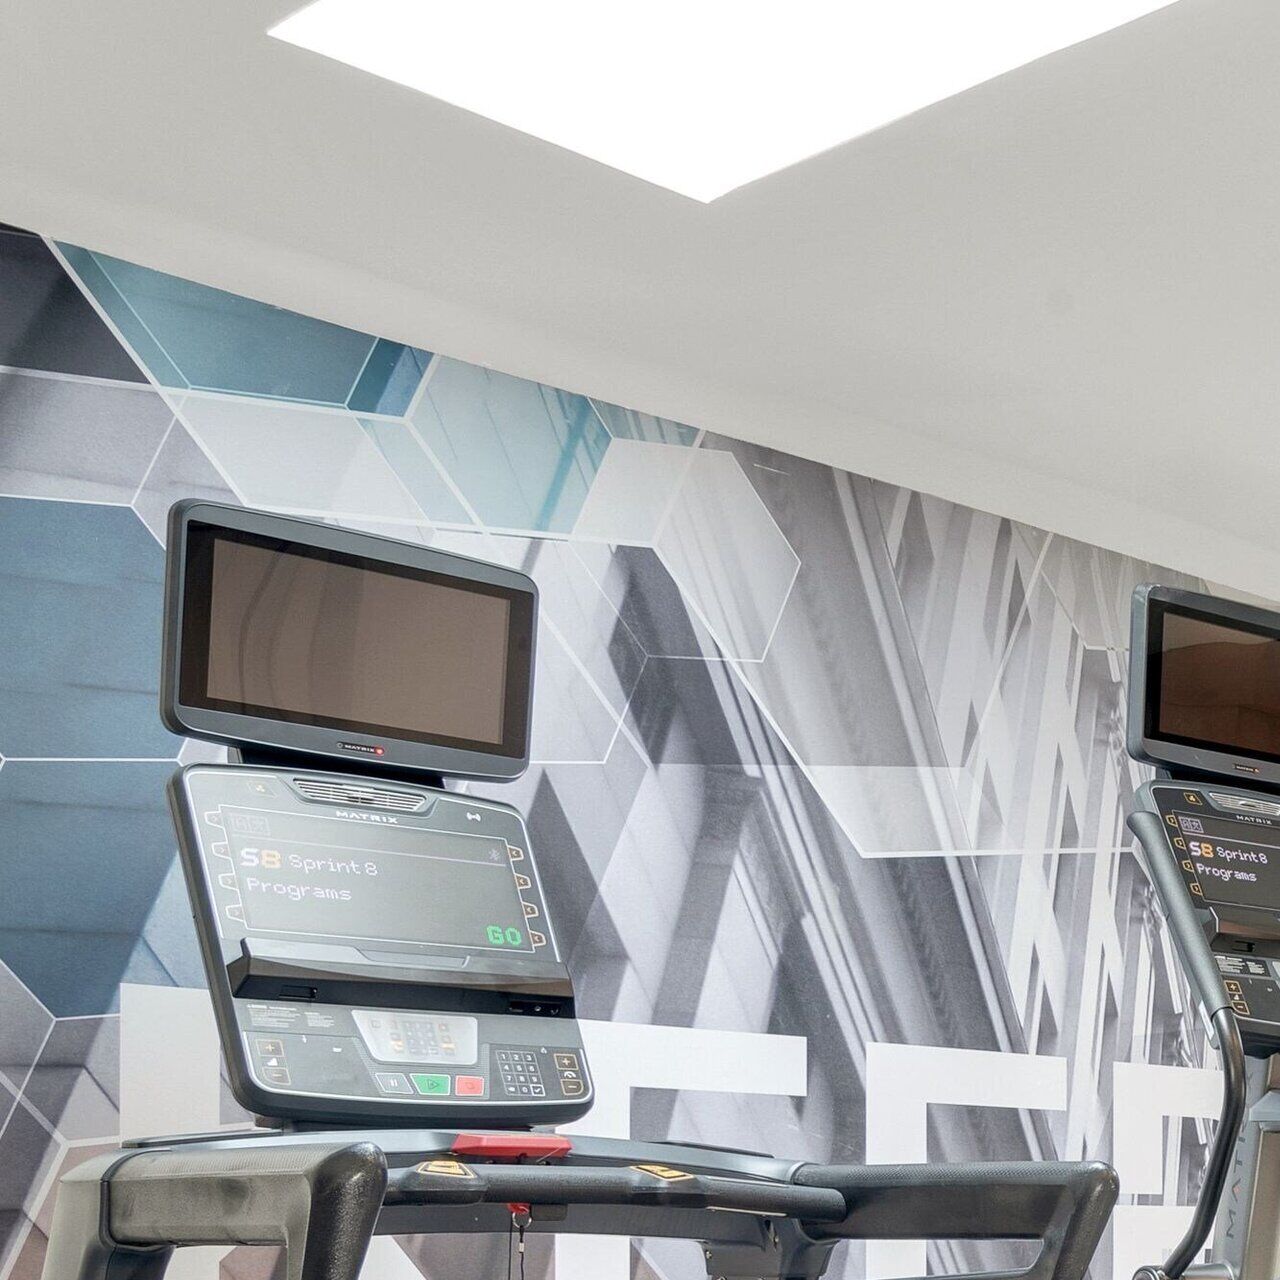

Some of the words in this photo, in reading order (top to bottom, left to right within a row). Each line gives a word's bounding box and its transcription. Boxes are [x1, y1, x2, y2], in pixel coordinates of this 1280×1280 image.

[335, 810, 398, 824] MATRIX
[1236, 814, 1273, 826] MATRIX
[239, 848, 282, 869] S8
[288, 854, 361, 874] Sprint
[365, 862, 379, 877] 8
[1189, 841, 1215, 858] S8
[1216, 846, 1260, 864] Sprint
[1259, 852, 1268, 865] 8
[1196, 863, 1258, 882] Programs
[246, 877, 353, 901] Programs
[486, 925, 522, 946] GO
